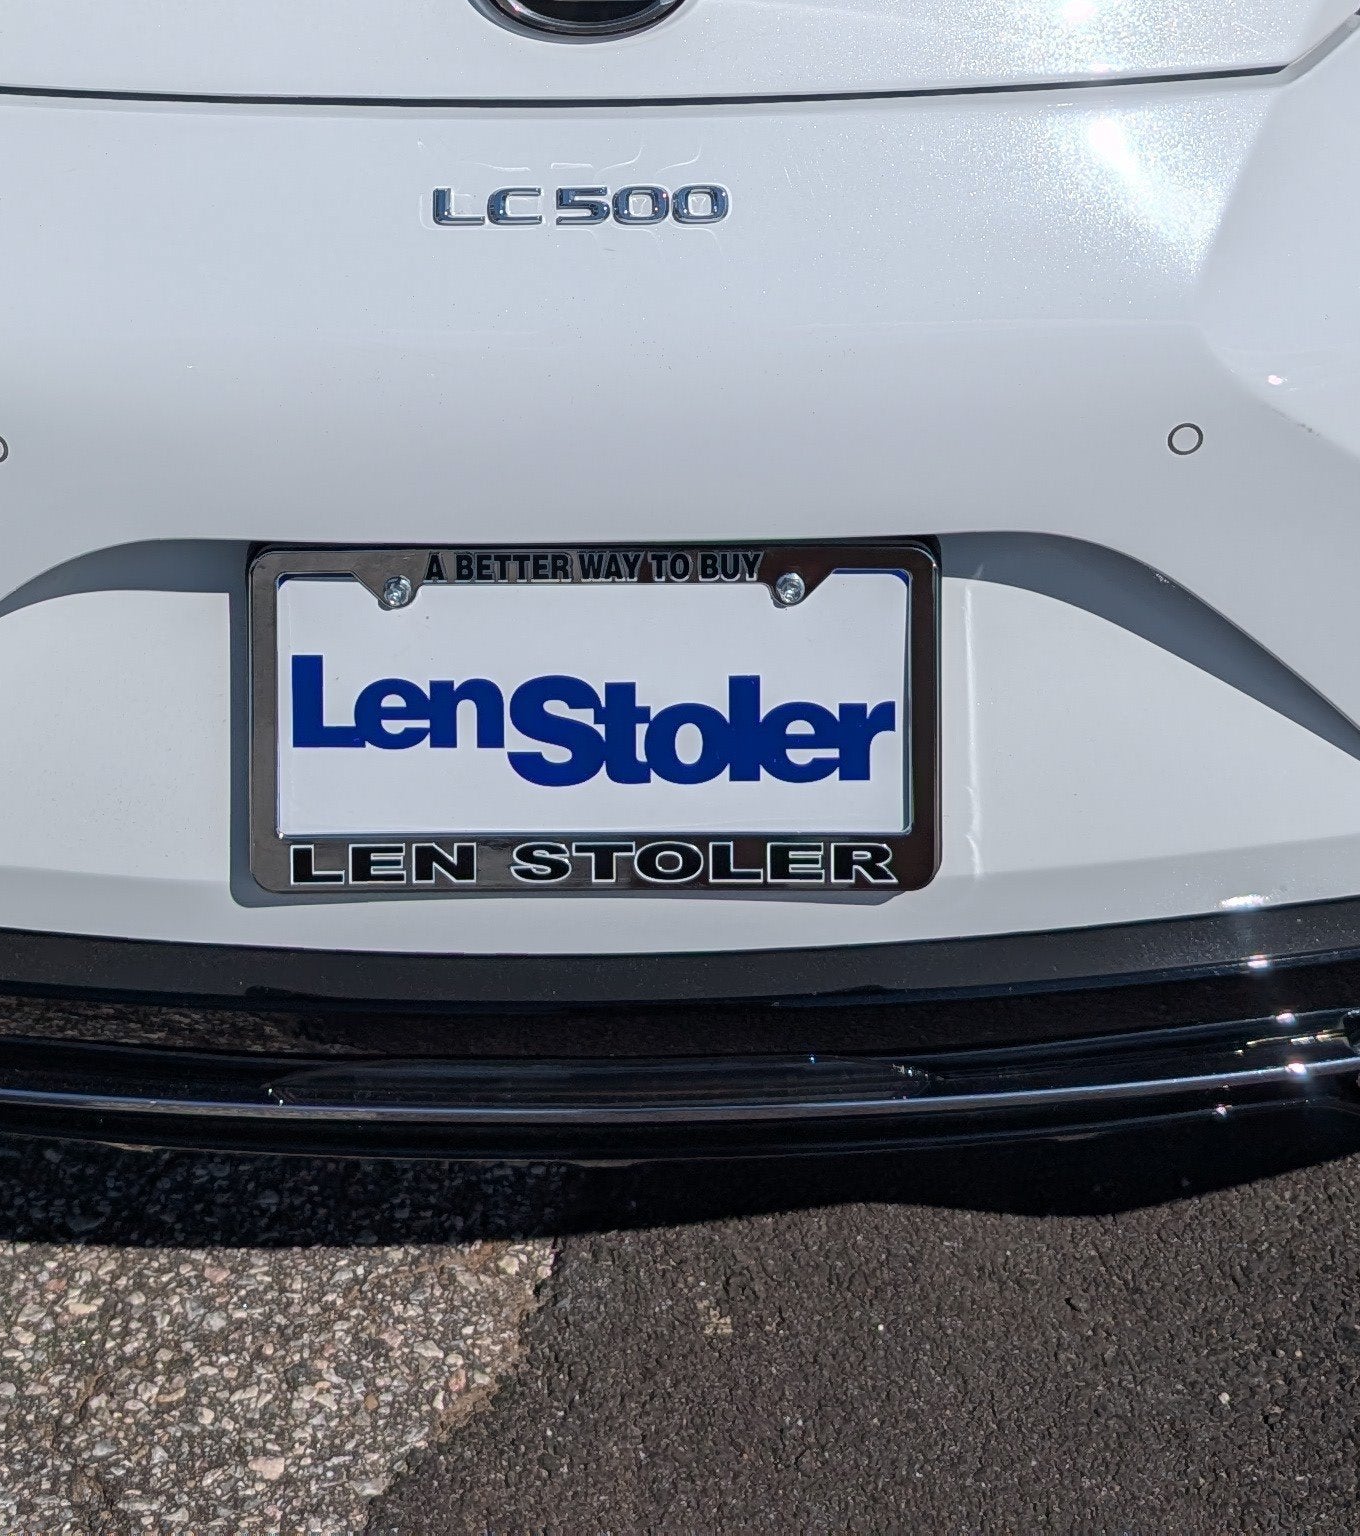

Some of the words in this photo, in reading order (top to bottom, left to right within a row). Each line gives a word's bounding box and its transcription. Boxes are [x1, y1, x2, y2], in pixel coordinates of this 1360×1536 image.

[423, 552, 447, 583] A
[454, 552, 574, 583] BETTER
[576, 551, 644, 583] WAY
[647, 552, 693, 582] TO
[697, 551, 764, 582] BUY
[289, 844, 478, 886] LEN
[509, 841, 899, 885] STOLER
